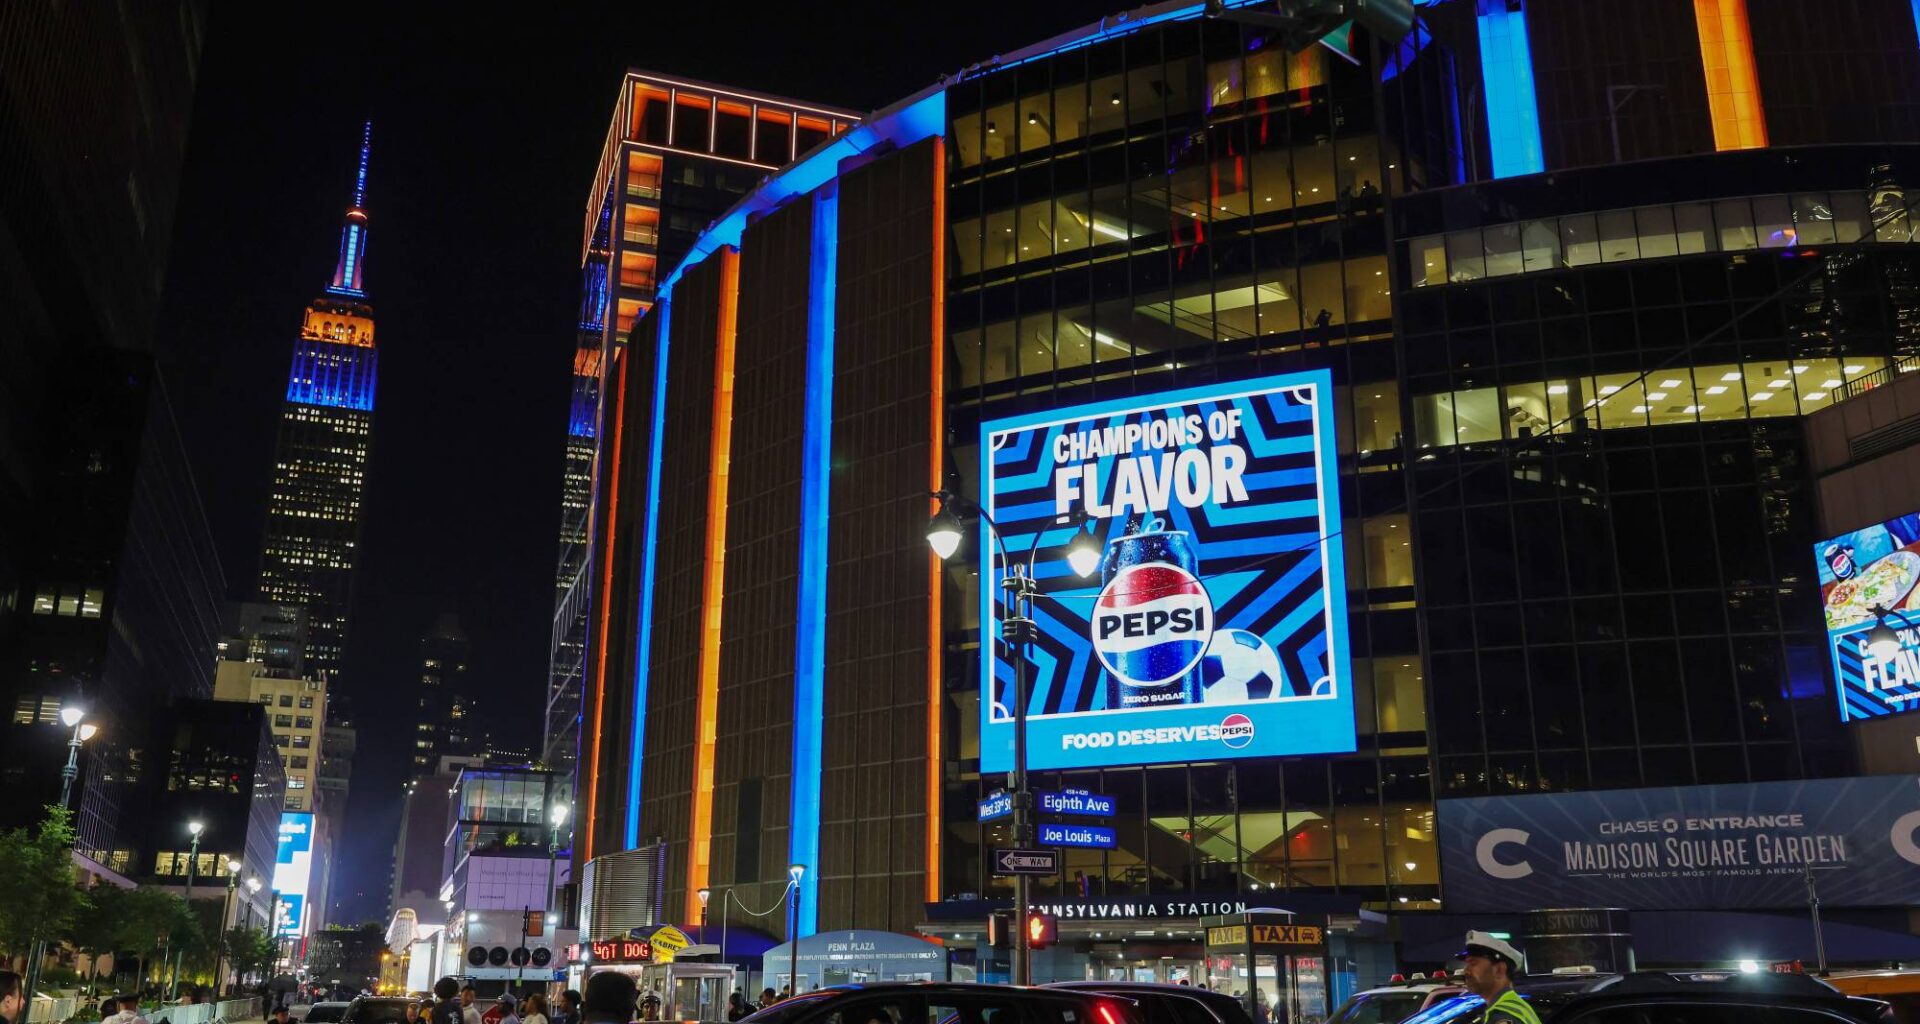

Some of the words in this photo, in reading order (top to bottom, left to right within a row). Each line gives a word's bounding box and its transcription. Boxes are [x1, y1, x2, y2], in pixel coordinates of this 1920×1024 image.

[1053, 414, 1204, 464] CHAMPIONS
[1208, 409, 1243, 441] OF
[1055, 444, 1250, 525] FLAVOR
[1099, 606, 1204, 640] PEPSI
[1123, 695, 1149, 704] ZERO
[1150, 692, 1185, 702] SUGAR
[1063, 732, 1114, 750] FOOD
[1117, 724, 1221, 746] DESERVES
[1221, 726, 1253, 736] PEPSI
[980, 803, 994, 818] West
[994, 798, 1004, 813] 33rd
[1004, 797, 1011, 811] St
[1044, 795, 1082, 811] Eighth
[1086, 798, 1110, 812] Ave
[1599, 820, 1660, 834] CHASE
[1686, 814, 1804, 831] ENTRANCE
[1044, 828, 1062, 841] Joe
[1065, 829, 1092, 843] Louis
[1094, 834, 1111, 843] Plaza
[1476, 828, 1533, 879] C
[1565, 841, 1659, 870] MADISON
[1665, 836, 1750, 869] SQUARE
[1756, 833, 1847, 864] GARDEN
[1006, 857, 1023, 866] ONE
[1029, 857, 1048, 866] WAY
[1028, 904, 1158, 917] NNSYLVANIA
[1167, 902, 1247, 916] STATION
[1209, 928, 1233, 944] TAXI
[1256, 926, 1299, 943] TAXI
[624, 943, 648, 958] DOG
[828, 943, 848, 952] PENN
[850, 943, 876, 952] PLAZA
